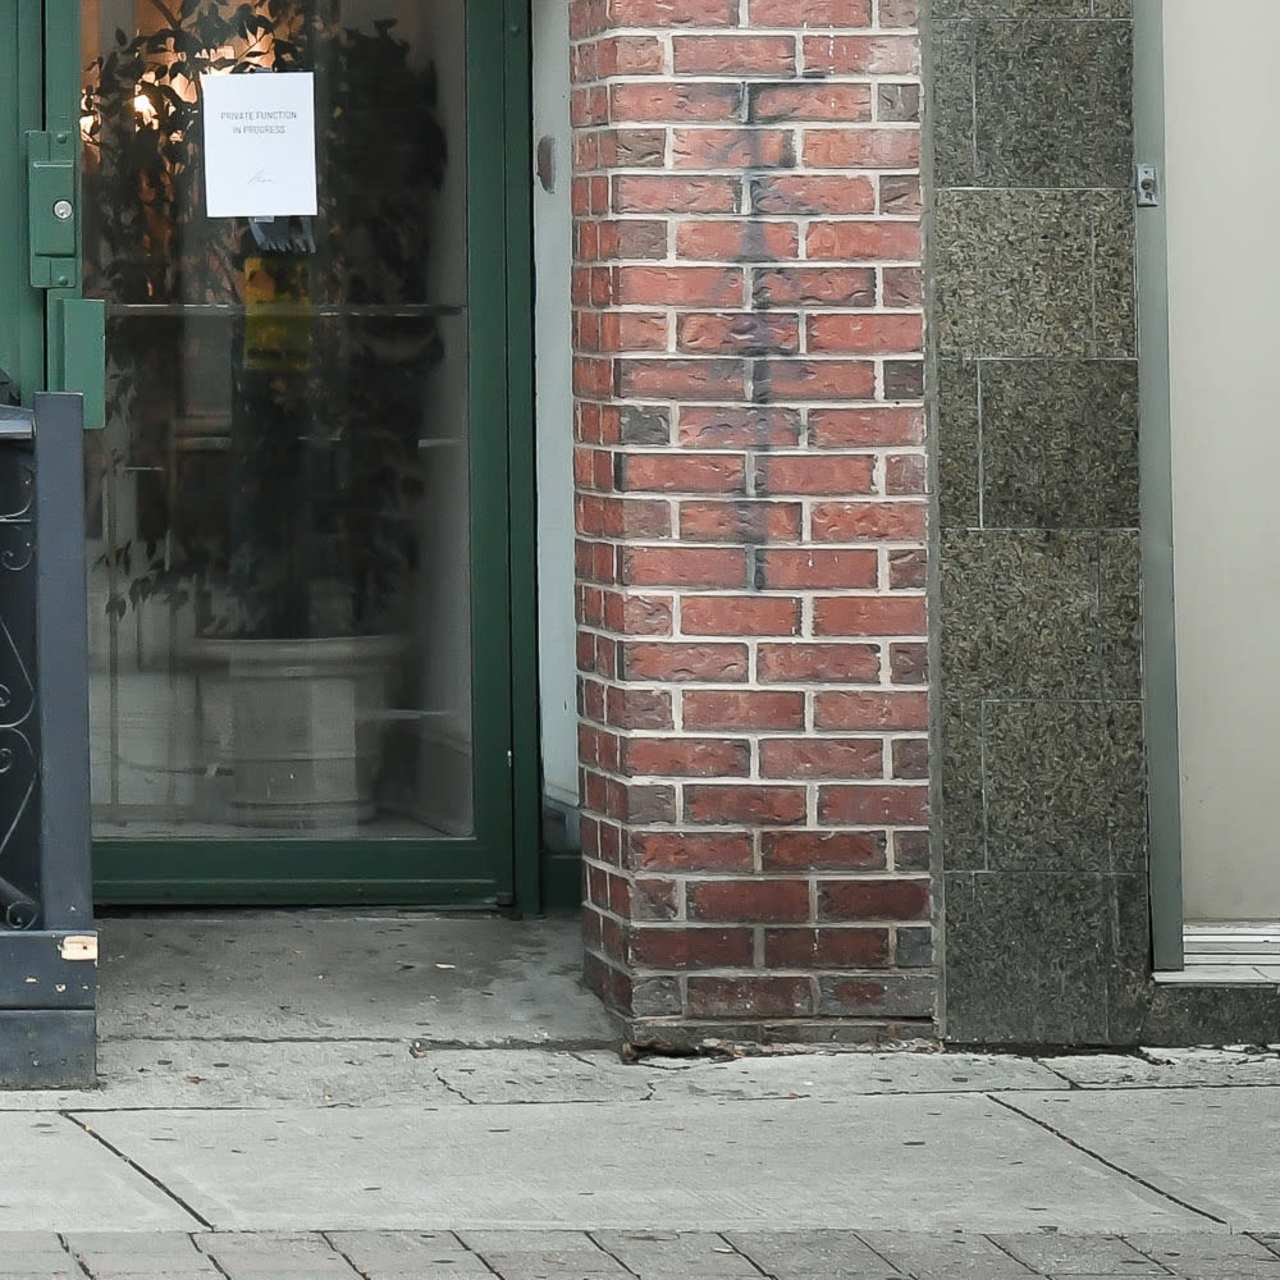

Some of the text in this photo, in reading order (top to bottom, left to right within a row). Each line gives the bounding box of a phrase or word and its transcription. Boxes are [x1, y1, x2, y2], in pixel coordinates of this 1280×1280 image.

[220, 111, 297, 120] PRIVATE FUNCTION
[232, 125, 286, 134] IN PROGRESS
